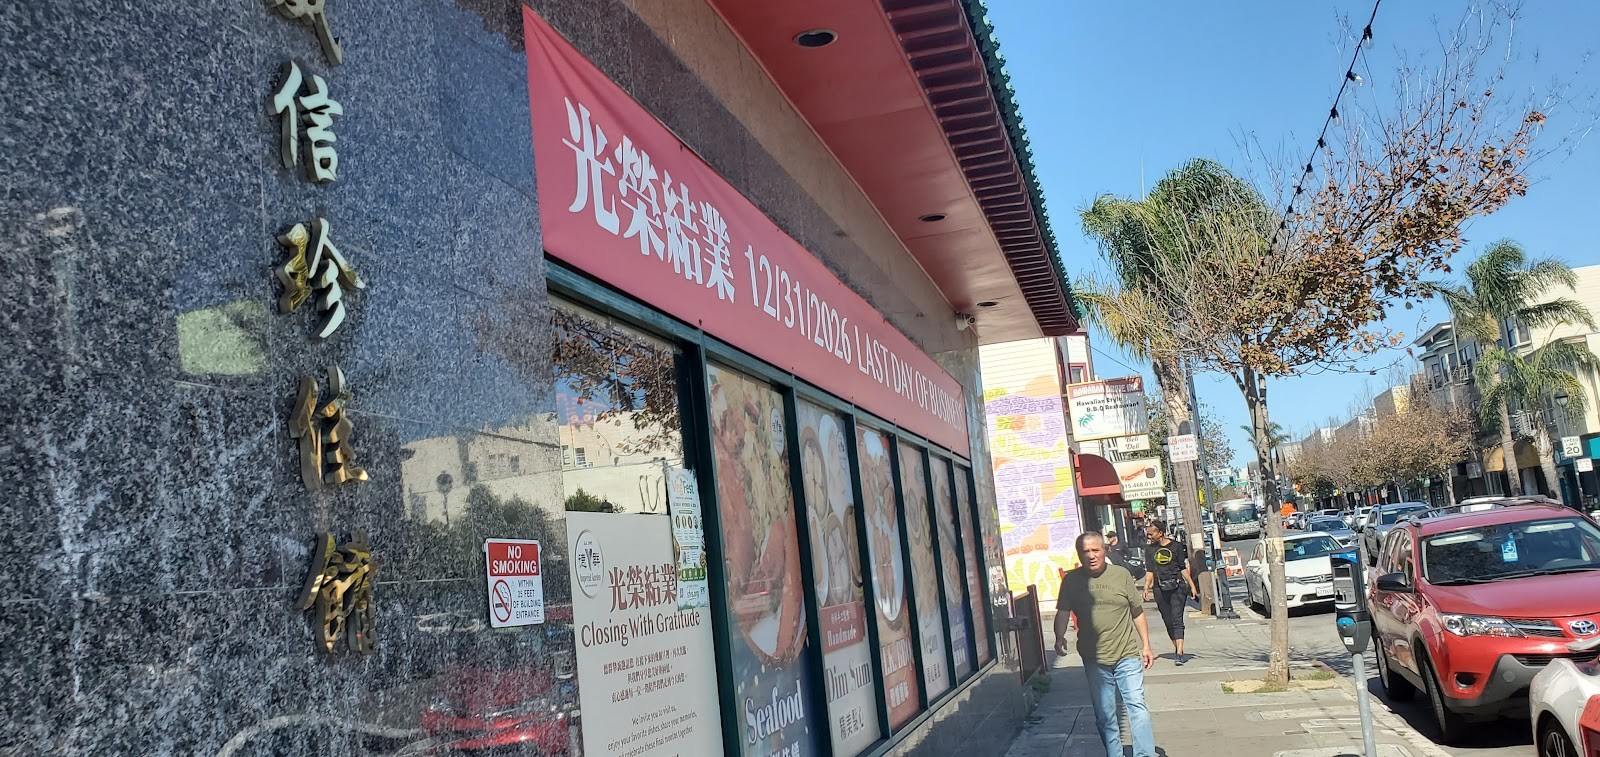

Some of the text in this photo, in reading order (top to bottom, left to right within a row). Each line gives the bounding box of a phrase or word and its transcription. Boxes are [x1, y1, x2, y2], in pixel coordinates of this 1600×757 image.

[562, 96, 736, 304] 光榮結業
[744, 244, 852, 365] 12/31/2026
[854, 325, 890, 388] LAST
[890, 351, 914, 402] DAY
[915, 370, 928, 411] OF
[1076, 398, 1105, 407] Hawaiian
[1105, 401, 1139, 411] Restaurant
[1566, 446, 1580, 455] 20
[1124, 480, 1158, 489] 15.468.0131
[507, 545, 522, 559] NO
[492, 560, 537, 574] SMOKING
[517, 589, 535, 598] 25 FEET
[608, 563, 678, 613] 光榮結業
[513, 599, 541, 609] OF BUILDING
[516, 609, 540, 619] ENTRANCE
[581, 608, 701, 648] Closing With Gratitude
[827, 623, 857, 647] Handmade
[825, 665, 849, 704] Dim
[848, 658, 871, 692] Sum
[745, 679, 804, 744] Seafood
[607, 739, 620, 752] enjoy
[631, 728, 648, 742] favorite
